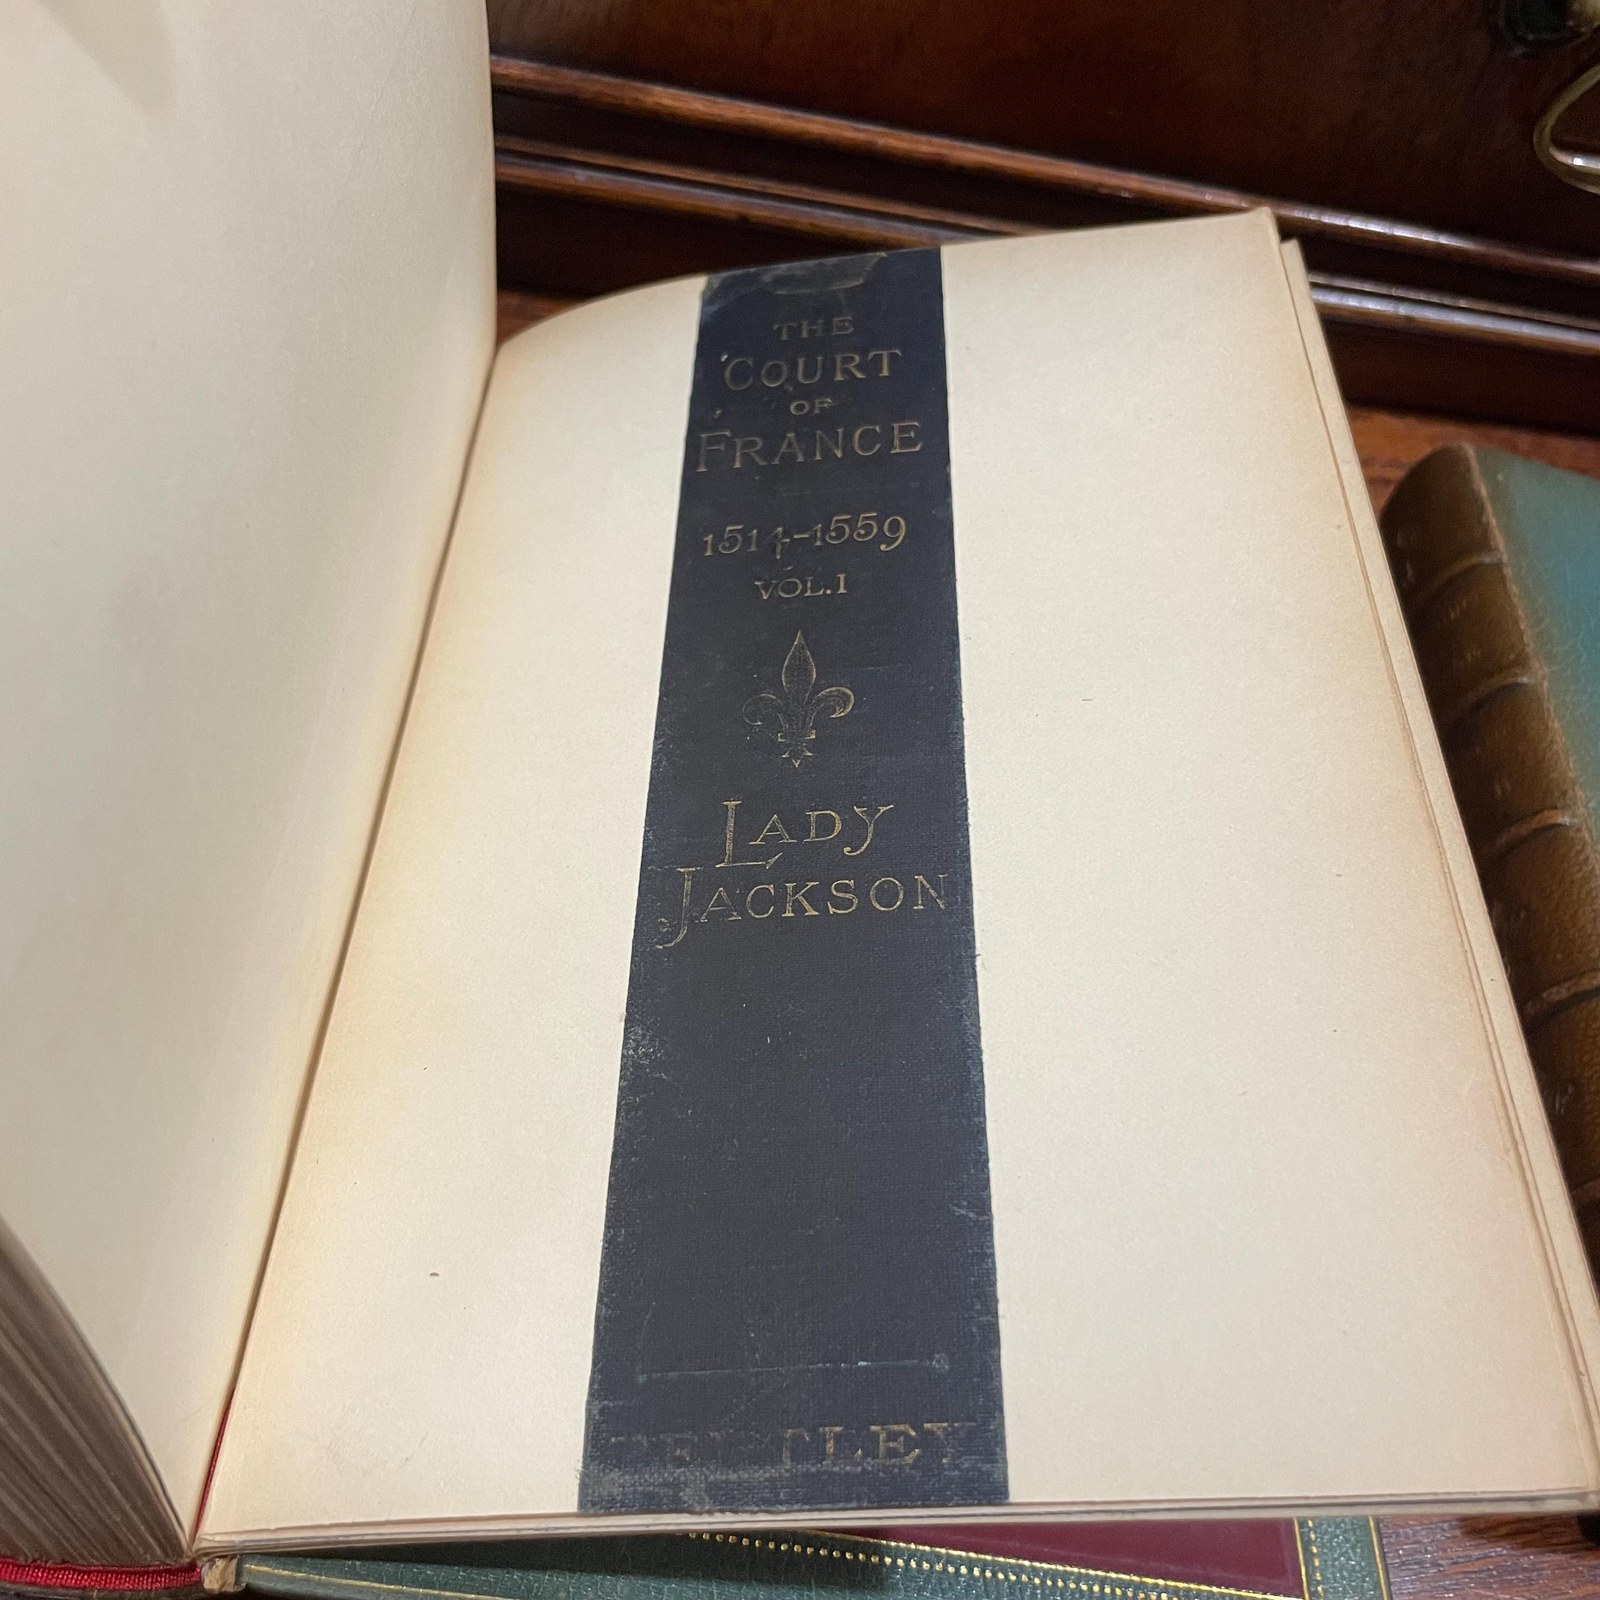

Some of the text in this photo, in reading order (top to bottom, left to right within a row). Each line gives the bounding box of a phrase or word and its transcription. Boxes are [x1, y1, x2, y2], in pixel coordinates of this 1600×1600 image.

[773, 316, 854, 341] THE
[724, 350, 902, 390] COURT
[789, 398, 833, 415] OF
[696, 421, 923, 473] FRANCE
[655, 866, 949, 949] JACKSON
